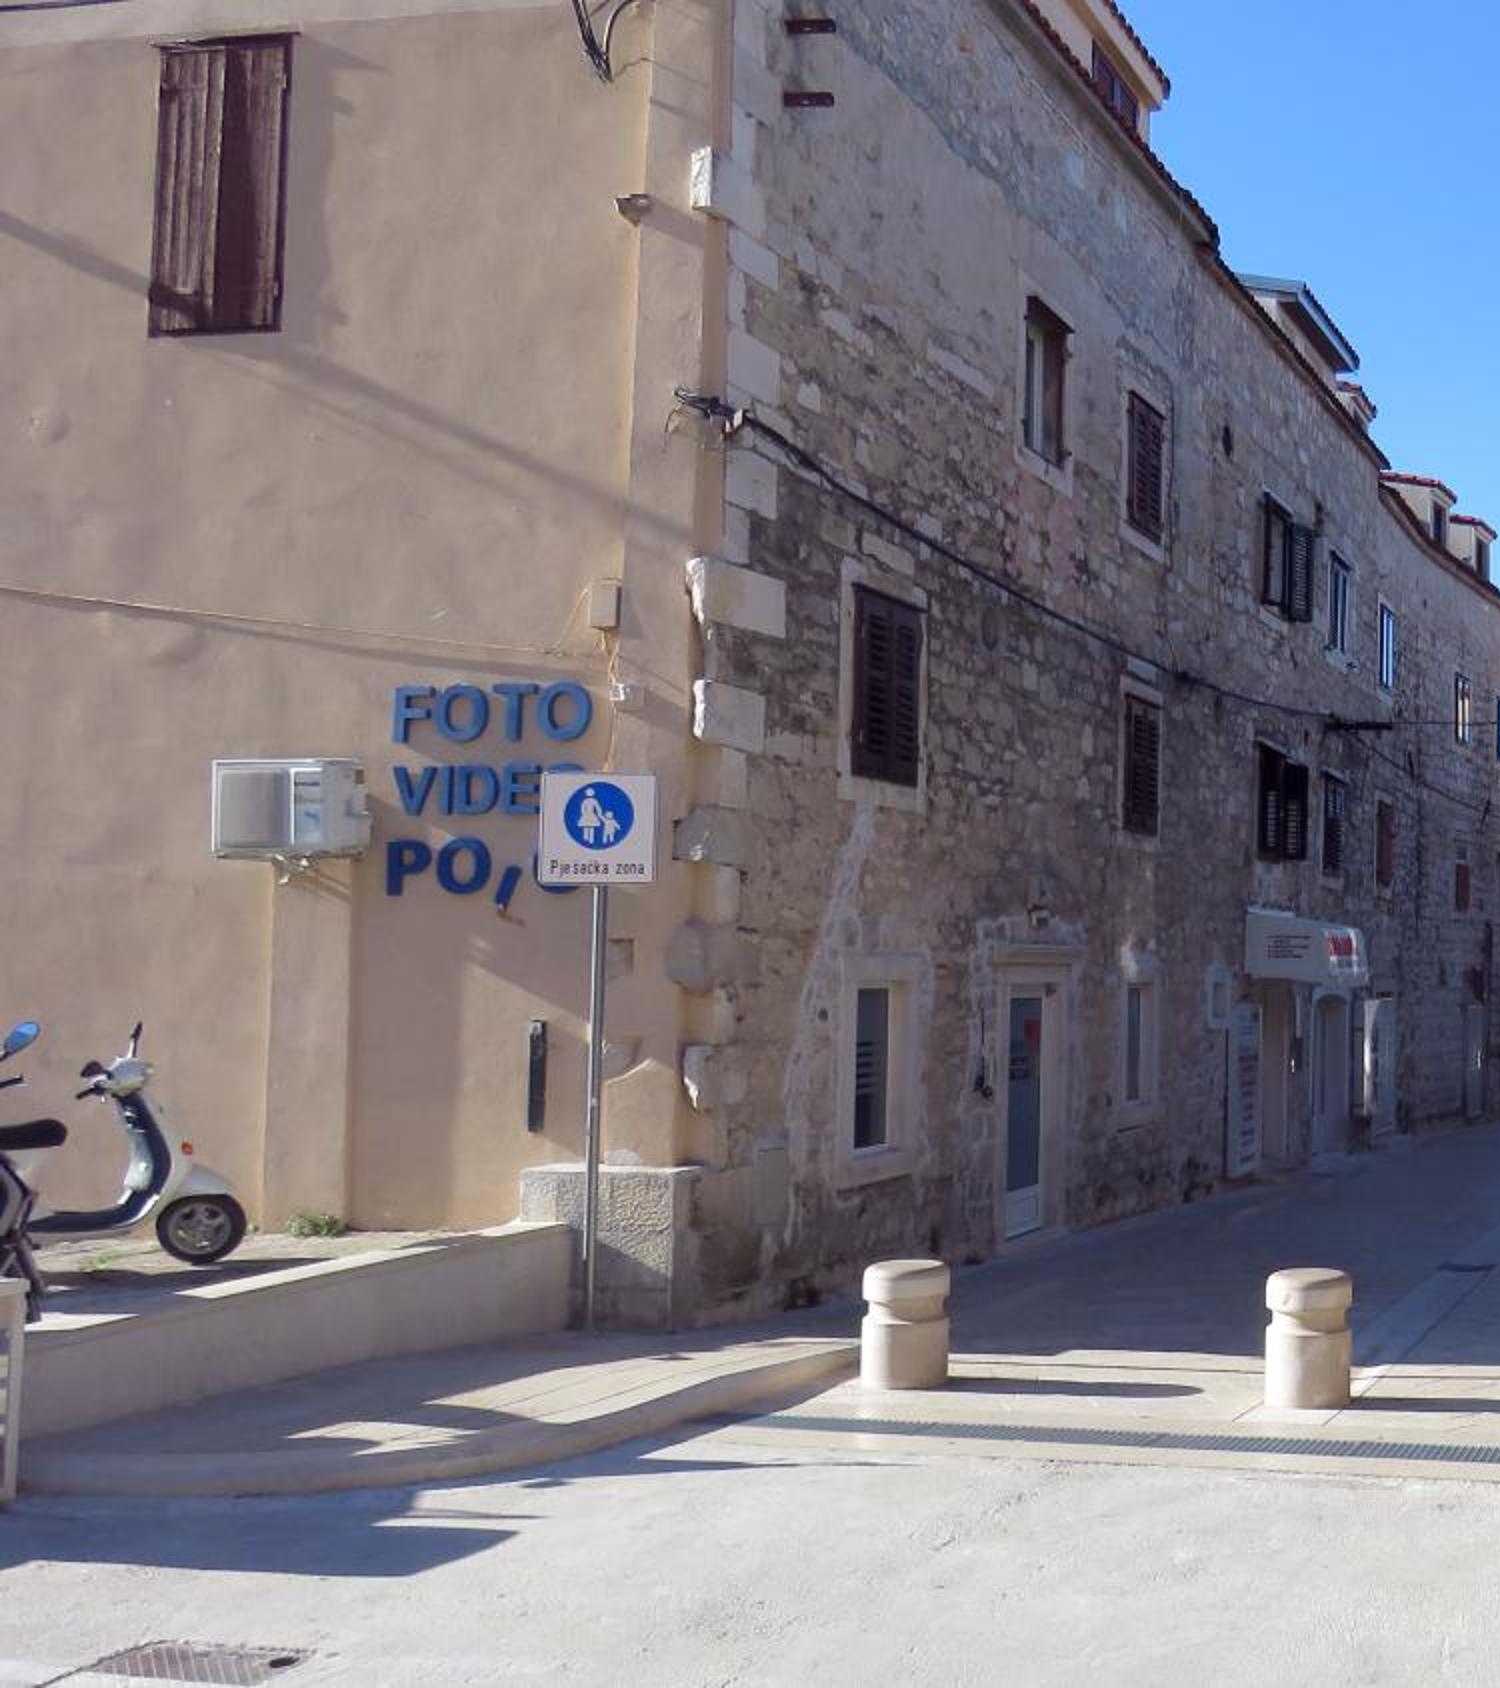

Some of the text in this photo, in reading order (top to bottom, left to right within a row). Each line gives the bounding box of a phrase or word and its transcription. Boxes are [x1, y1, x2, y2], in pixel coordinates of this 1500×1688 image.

[392, 681, 593, 743] FOTO
[393, 763, 587, 816] VIDE
[615, 863, 645, 876] zona
